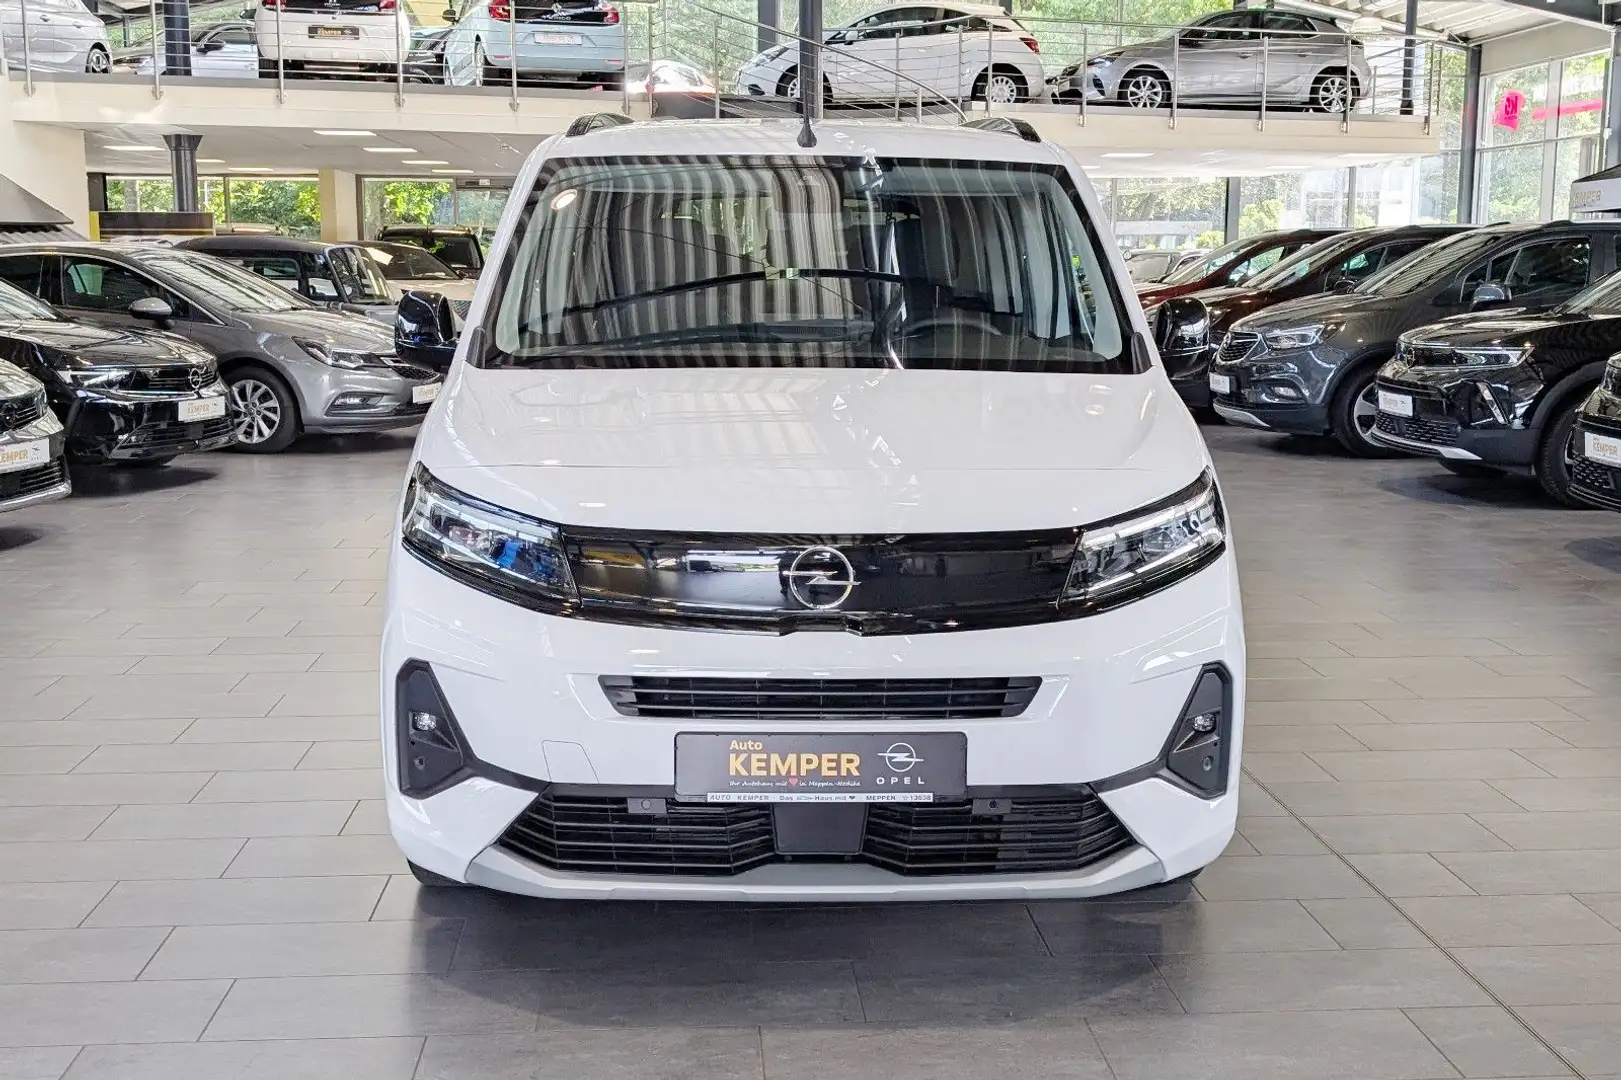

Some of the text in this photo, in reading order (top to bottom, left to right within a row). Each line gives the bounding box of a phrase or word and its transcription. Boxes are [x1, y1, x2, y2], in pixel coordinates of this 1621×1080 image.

[0, 449, 28, 463] EMPER
[730, 740, 763, 750] Auto
[729, 753, 861, 777] KEMPER
[876, 777, 925, 785] OPEL
